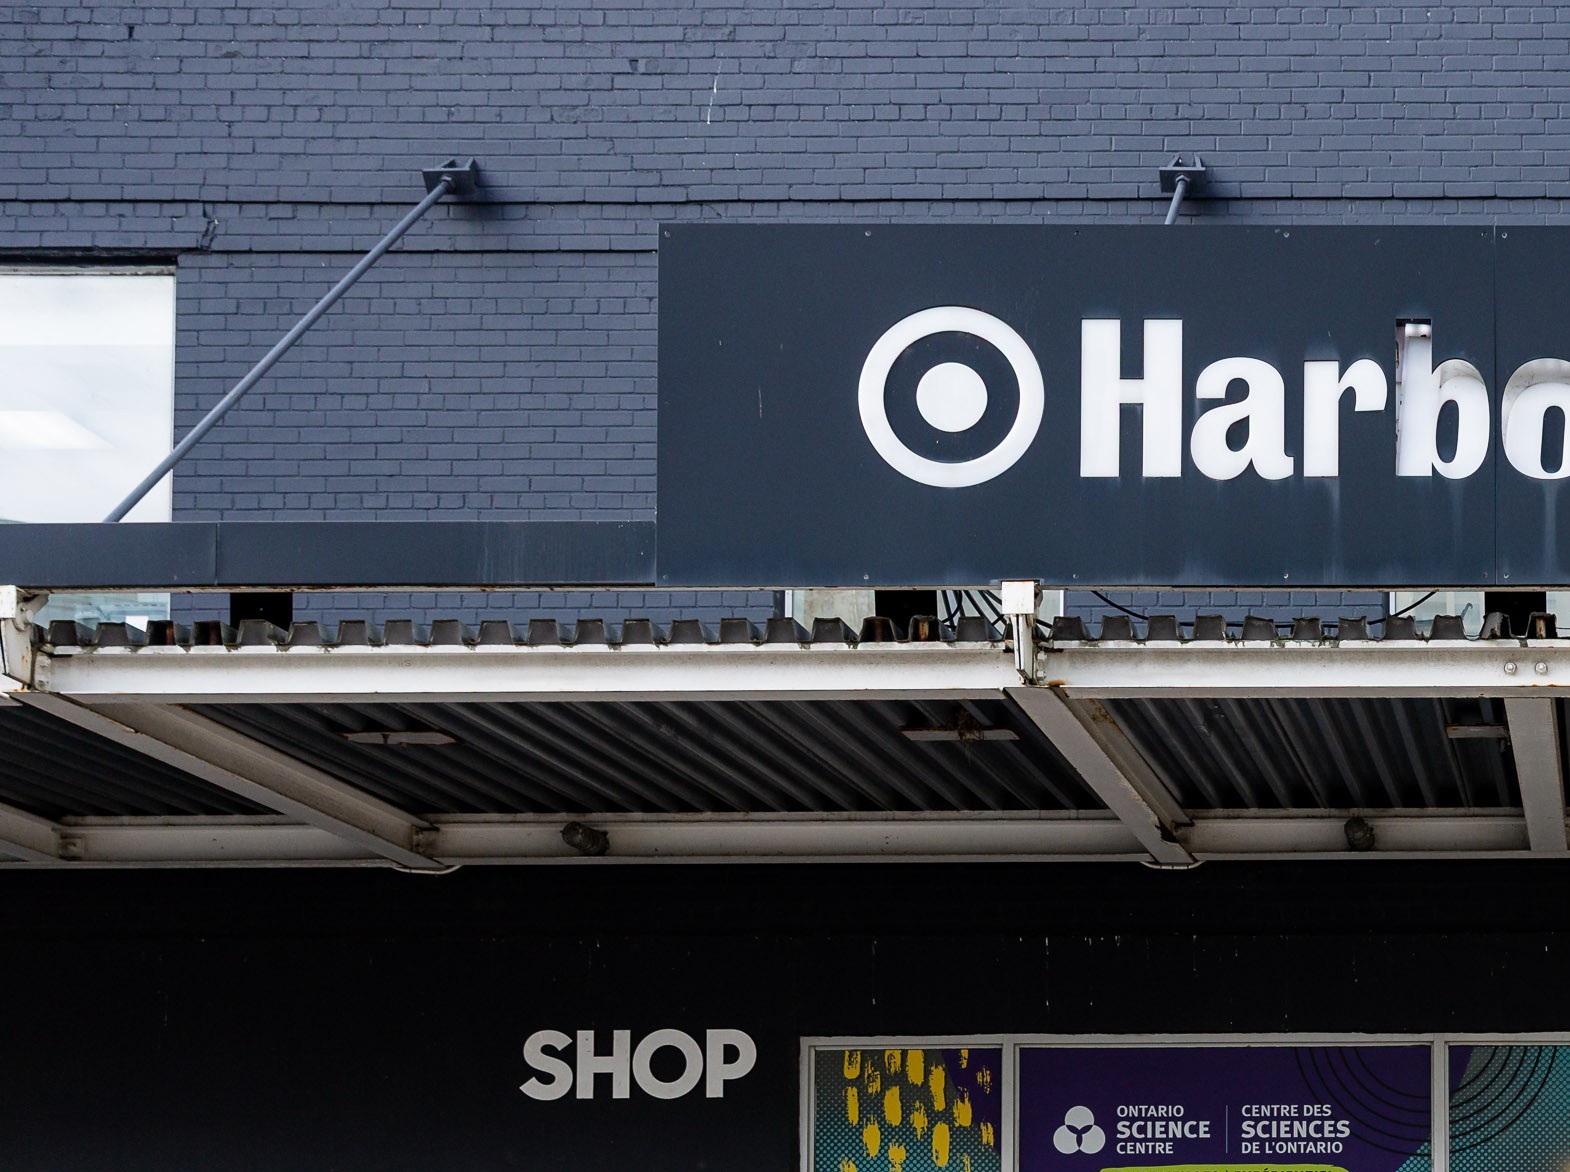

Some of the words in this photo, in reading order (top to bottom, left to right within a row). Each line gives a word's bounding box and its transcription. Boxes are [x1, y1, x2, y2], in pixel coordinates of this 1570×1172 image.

[519, 1028, 757, 1101] SHOP
[1116, 1105, 1184, 1118] ONTARIO
[1241, 1104, 1299, 1117] CENTRE
[1303, 1104, 1332, 1117] DES
[1116, 1120, 1211, 1139] SCIENCE
[1241, 1119, 1351, 1139] SCIENCES
[1116, 1142, 1174, 1155] CENTRE
[1241, 1141, 1261, 1154] DE
